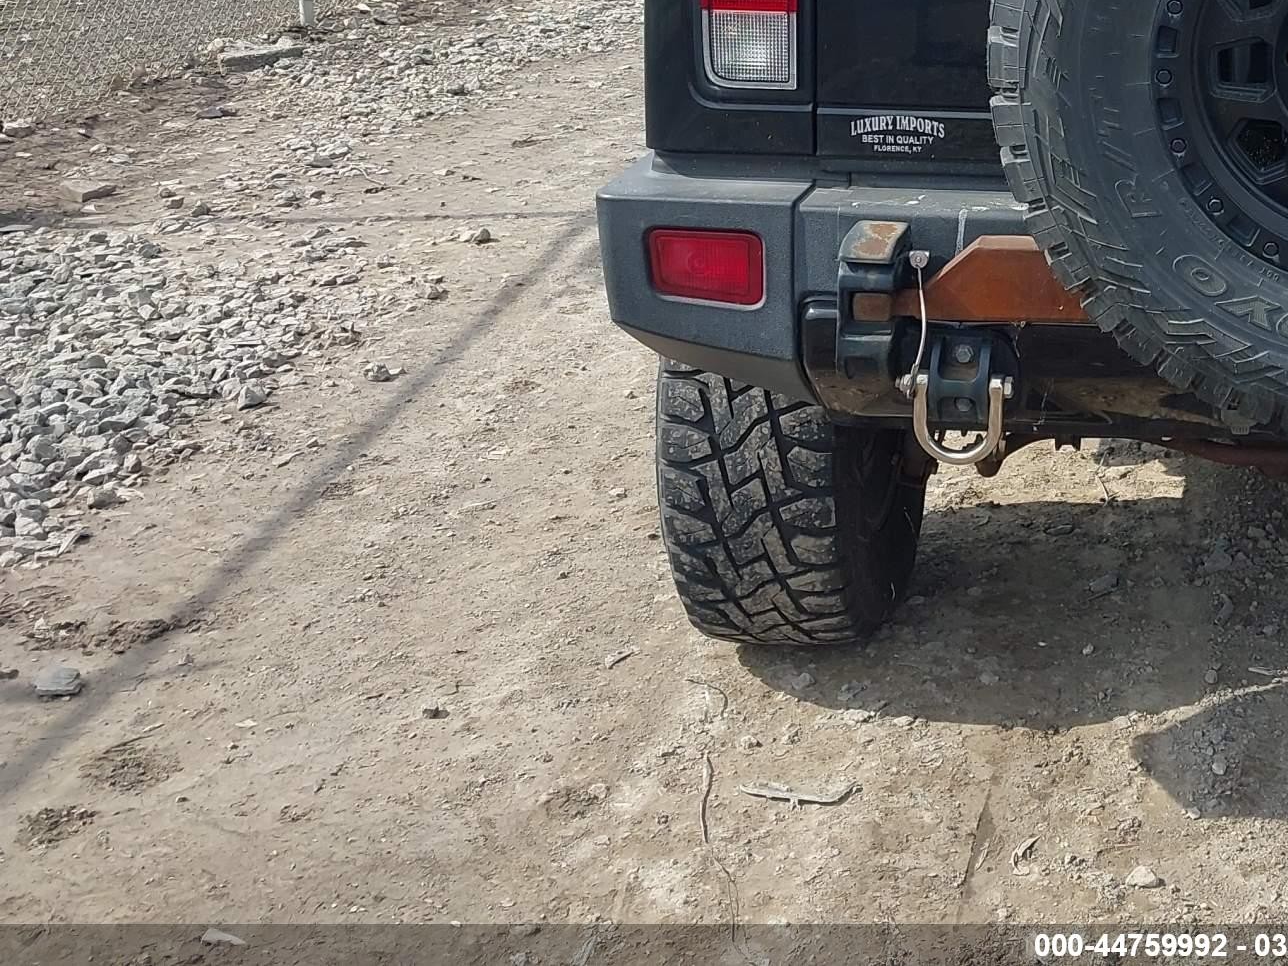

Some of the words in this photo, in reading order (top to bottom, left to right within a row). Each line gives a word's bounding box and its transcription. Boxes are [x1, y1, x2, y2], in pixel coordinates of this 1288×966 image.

[850, 115, 894, 136] LUXURY
[896, 115, 945, 139] IMPORTS
[861, 134, 885, 143] BEST
[886, 135, 895, 144] IN
[896, 135, 935, 145] QUALITY
[873, 145, 912, 154] FLORENCE,
